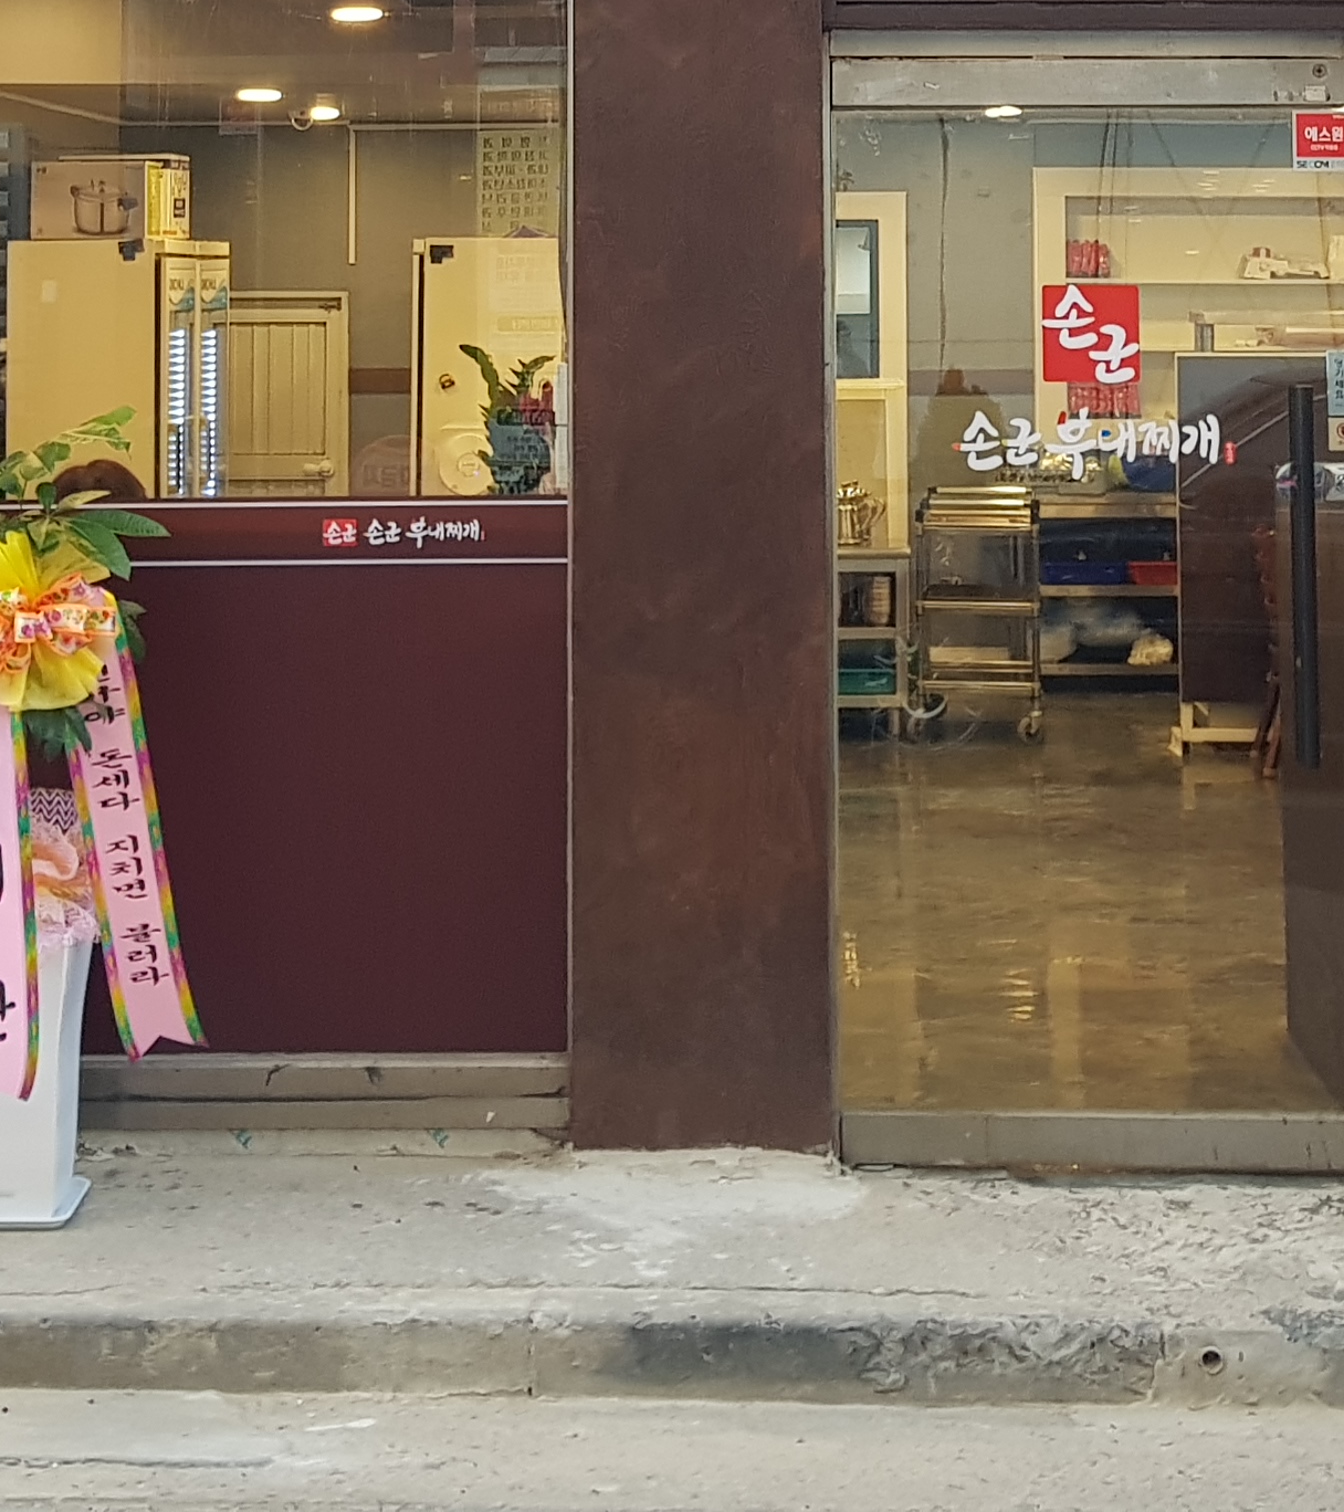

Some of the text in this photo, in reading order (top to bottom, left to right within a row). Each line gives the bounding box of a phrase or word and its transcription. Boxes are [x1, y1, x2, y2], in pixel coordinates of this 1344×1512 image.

[1304, 126, 1344, 143] 에스원
[1040, 284, 1140, 384] 손군
[951, 407, 1220, 480] 손군 부대찌개
[323, 520, 357, 545] 손군
[362, 518, 402, 546] 손군
[104, 834, 149, 900] 지치면
